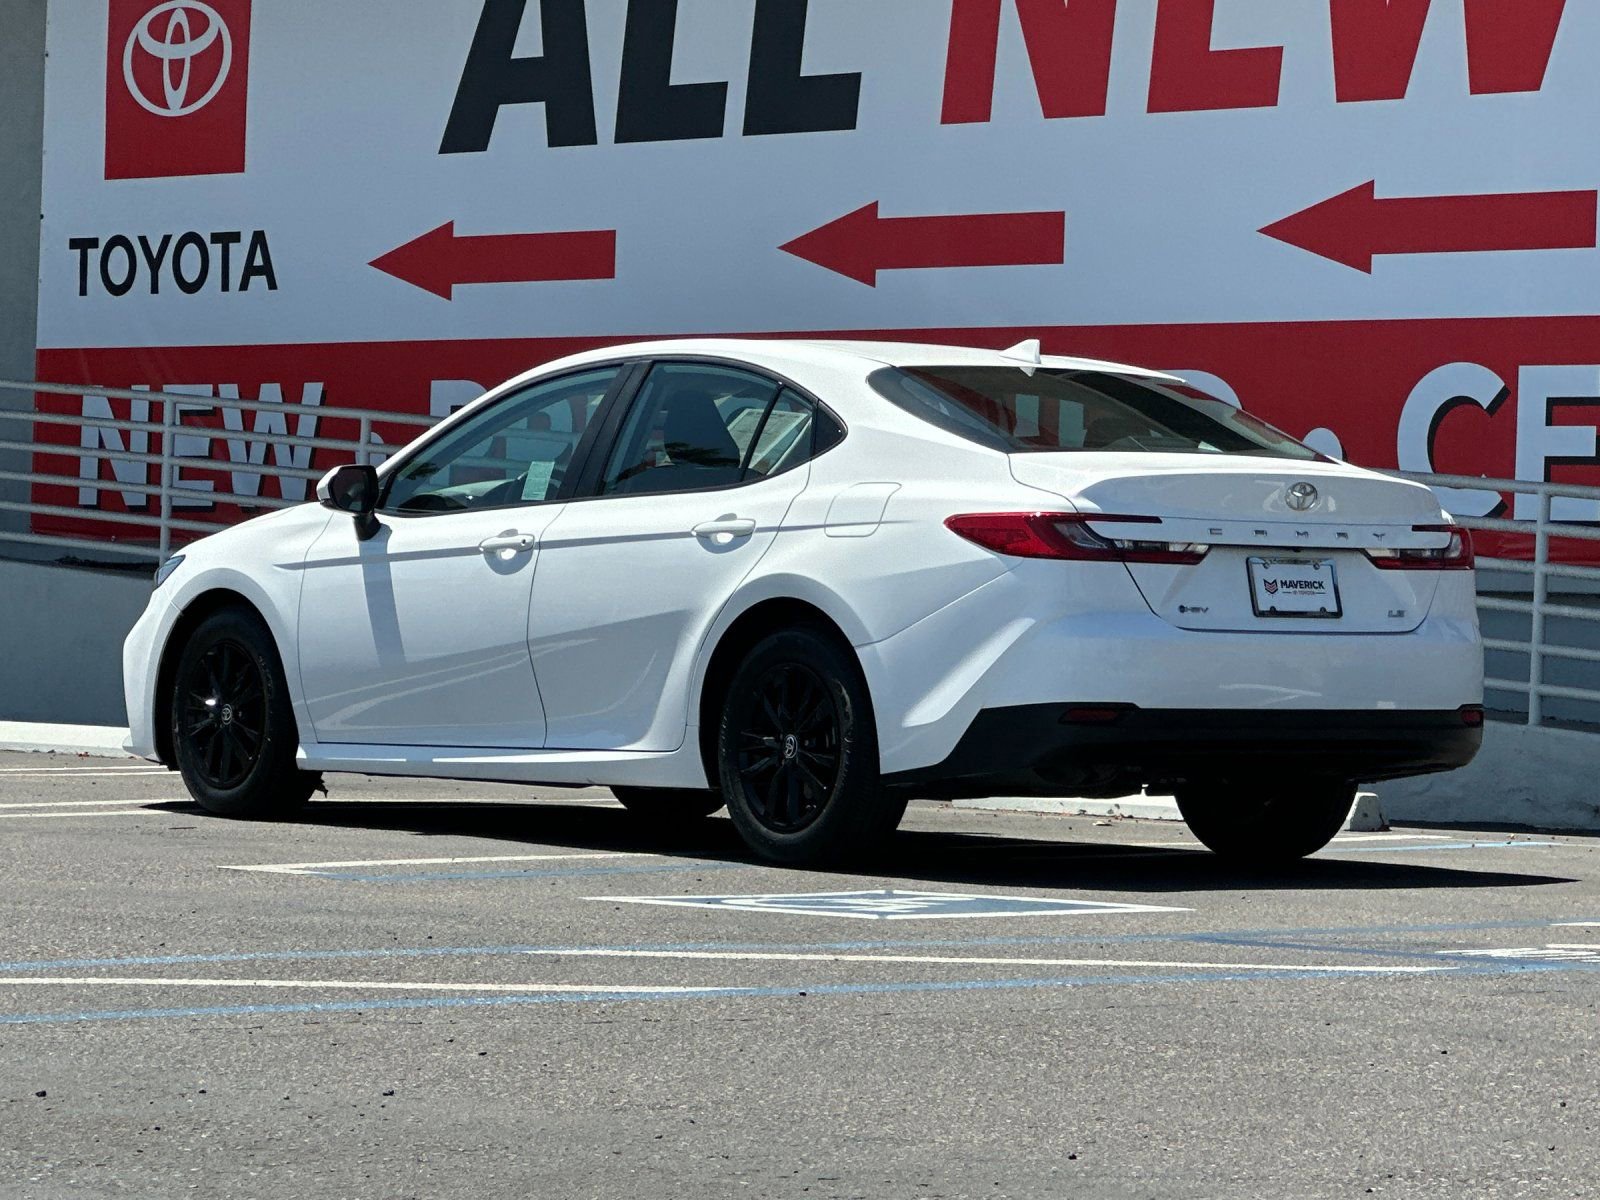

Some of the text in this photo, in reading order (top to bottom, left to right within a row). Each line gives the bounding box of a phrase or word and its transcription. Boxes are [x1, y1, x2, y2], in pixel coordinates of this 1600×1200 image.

[438, 0, 861, 155] ALL
[68, 229, 278, 297] TOYOTA
[78, 381, 326, 511] NEW
[1280, 579, 1326, 590] MAVERICK
